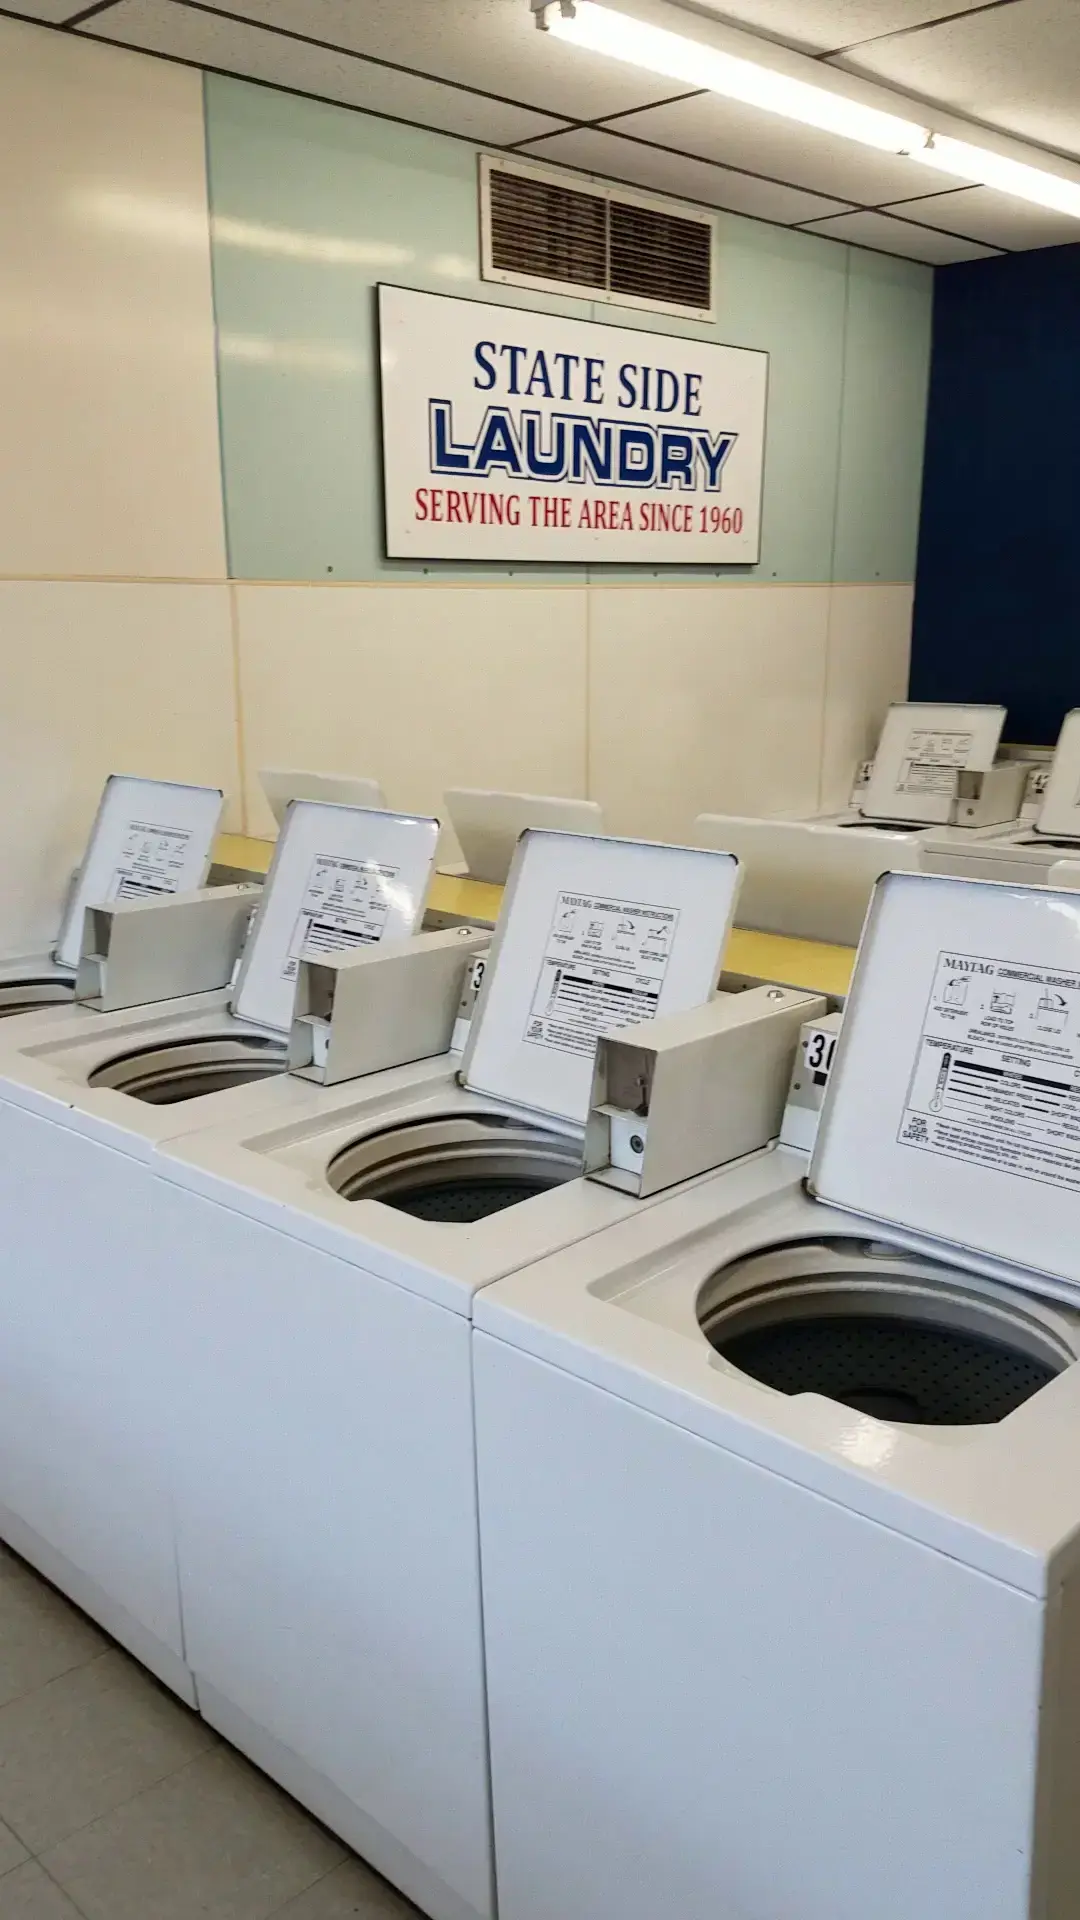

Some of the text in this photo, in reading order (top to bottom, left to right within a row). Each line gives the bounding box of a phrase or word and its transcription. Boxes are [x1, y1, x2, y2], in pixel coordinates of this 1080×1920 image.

[473, 341, 703, 417] STATE SIDE
[428, 398, 739, 493] LAUNDRY
[415, 488, 744, 535] SERVING THE AREA SINCE 1960
[943, 957, 995, 976] MAYTAG
[809, 1034, 837, 1071] 3
[925, 1038, 974, 1055] TEMPERATURE
[1000, 1054, 1032, 1067] SETTING
[908, 1124, 927, 1133] YOUR
[911, 1117, 926, 1125] FOR
